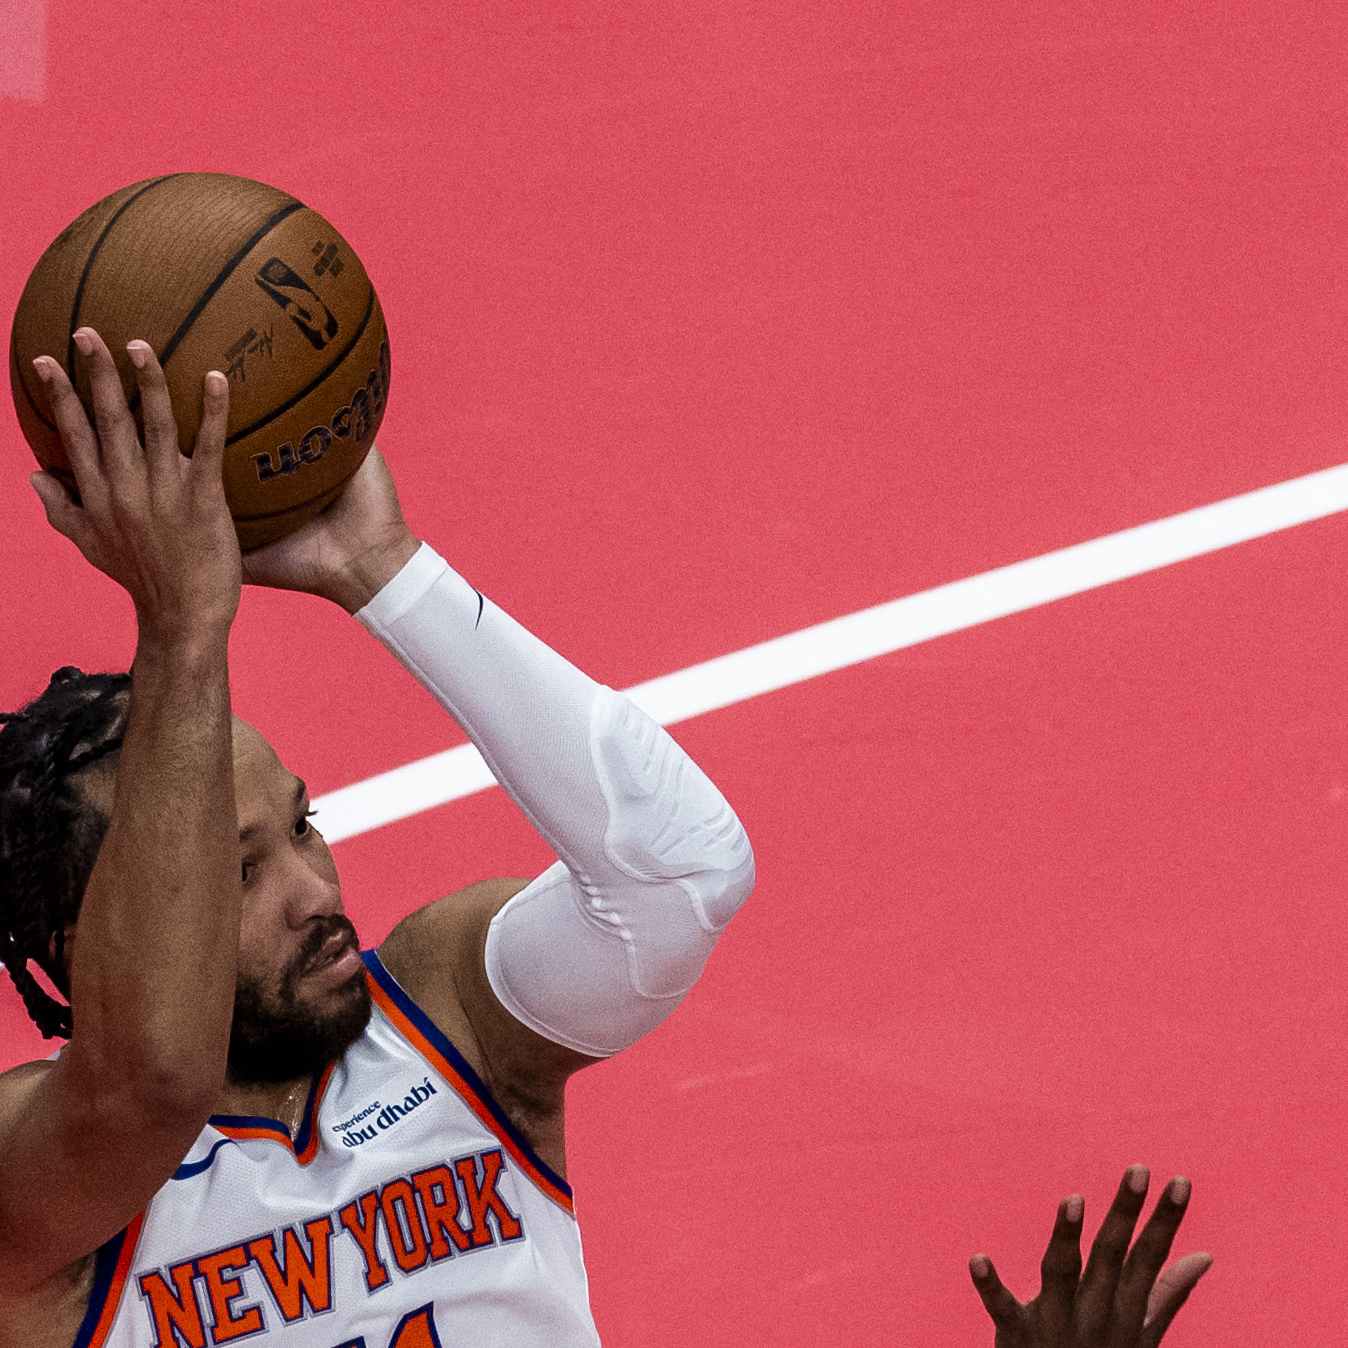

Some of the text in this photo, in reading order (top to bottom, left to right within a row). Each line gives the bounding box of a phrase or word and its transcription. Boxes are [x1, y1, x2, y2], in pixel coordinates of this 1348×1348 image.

[250, 342, 390, 484] ilson
[332, 1100, 381, 1132] experience
[342, 1076, 438, 1147] abu dhabi
[337, 1145, 526, 1296] YORK
